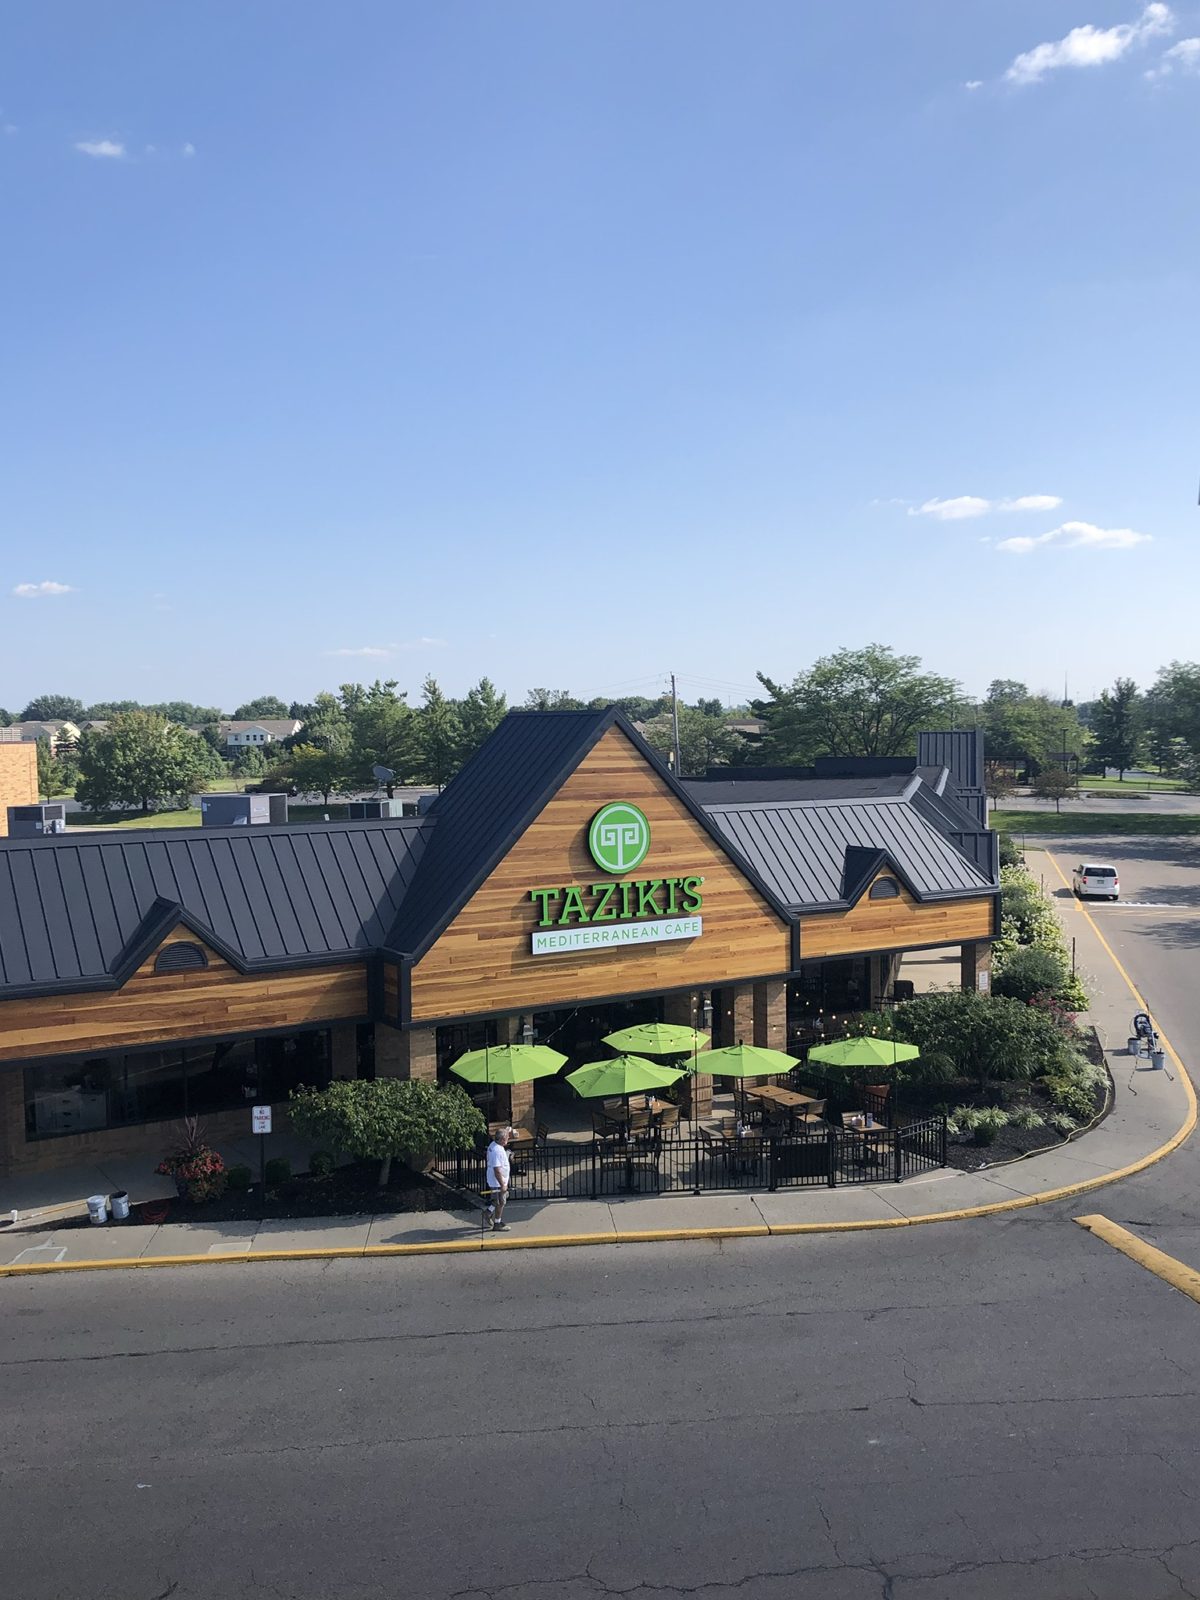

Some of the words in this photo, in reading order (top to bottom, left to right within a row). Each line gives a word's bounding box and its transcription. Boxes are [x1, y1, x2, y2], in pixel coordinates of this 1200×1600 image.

[530, 876, 704, 926] TAZIKI'S
[536, 925, 660, 949] MEDITERRANEAN
[664, 921, 699, 936] CAFE
